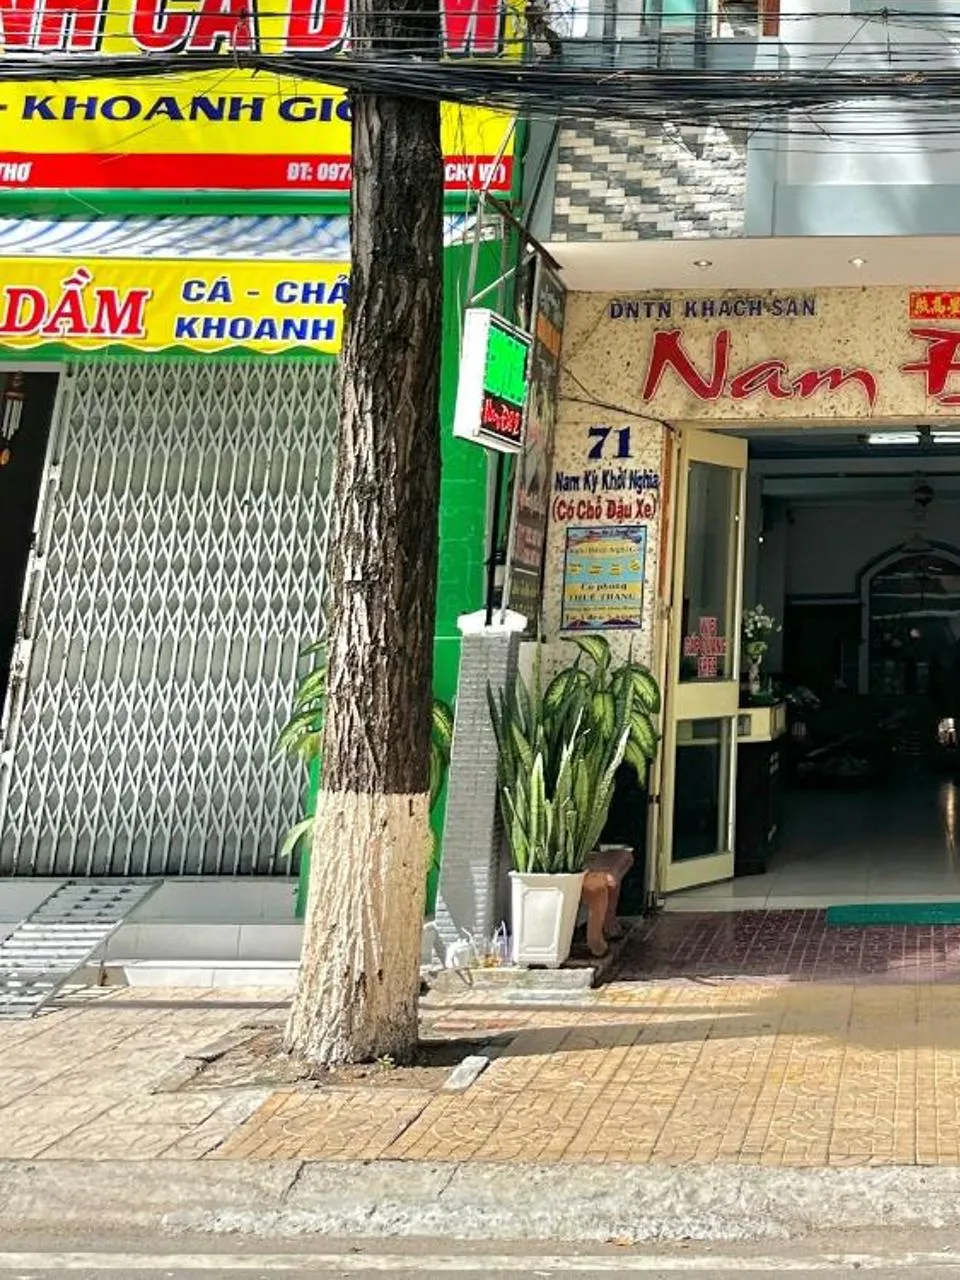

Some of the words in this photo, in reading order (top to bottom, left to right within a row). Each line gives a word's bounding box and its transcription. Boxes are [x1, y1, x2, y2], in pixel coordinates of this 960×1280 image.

[22, 95, 266, 122] KHOANH
[0, 268, 149, 337] DẦM
[181, 276, 232, 303] CÁ
[610, 300, 672, 319] DNTN
[175, 317, 336, 341] KHOANH
[642, 328, 878, 415] Nam
[587, 425, 634, 460] 71
[555, 471, 580, 492] Nam
